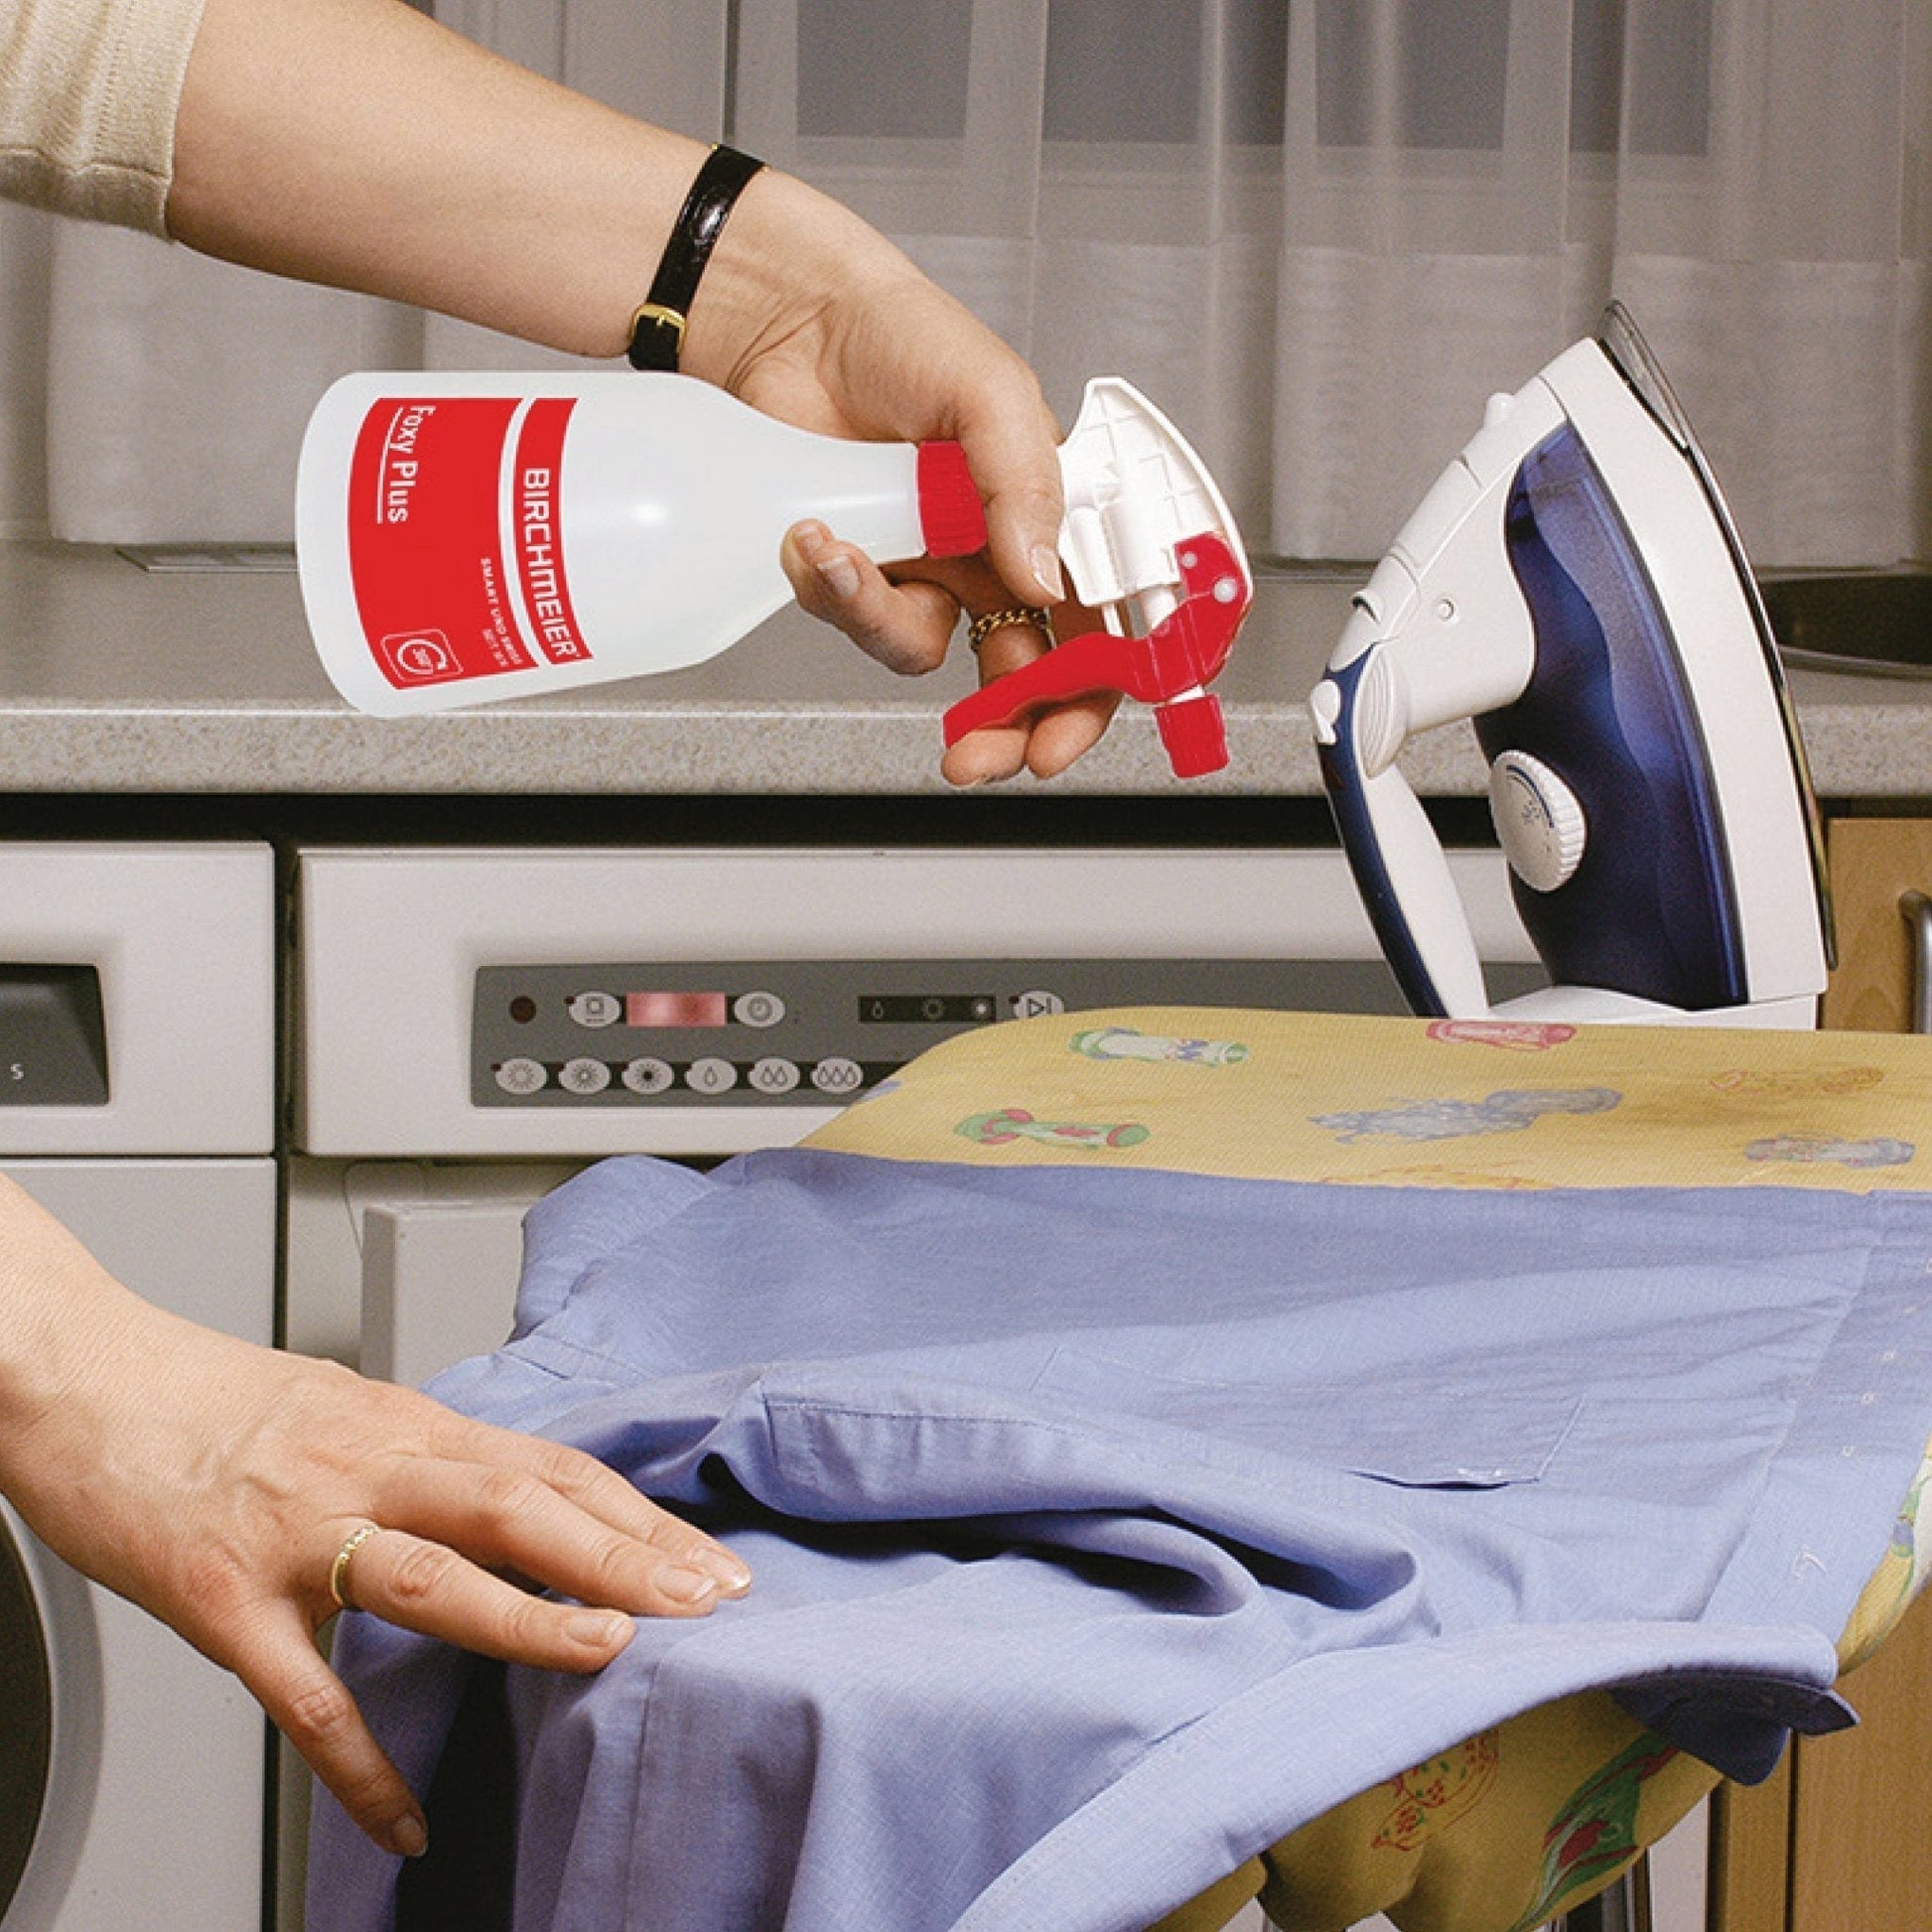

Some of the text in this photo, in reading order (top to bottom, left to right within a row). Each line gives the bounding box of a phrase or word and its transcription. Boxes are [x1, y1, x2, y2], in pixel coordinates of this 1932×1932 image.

[386, 405, 436, 523] Foxy Plus
[481, 557, 498, 604] SMART
[522, 468, 578, 656] BIRCHMEIER
